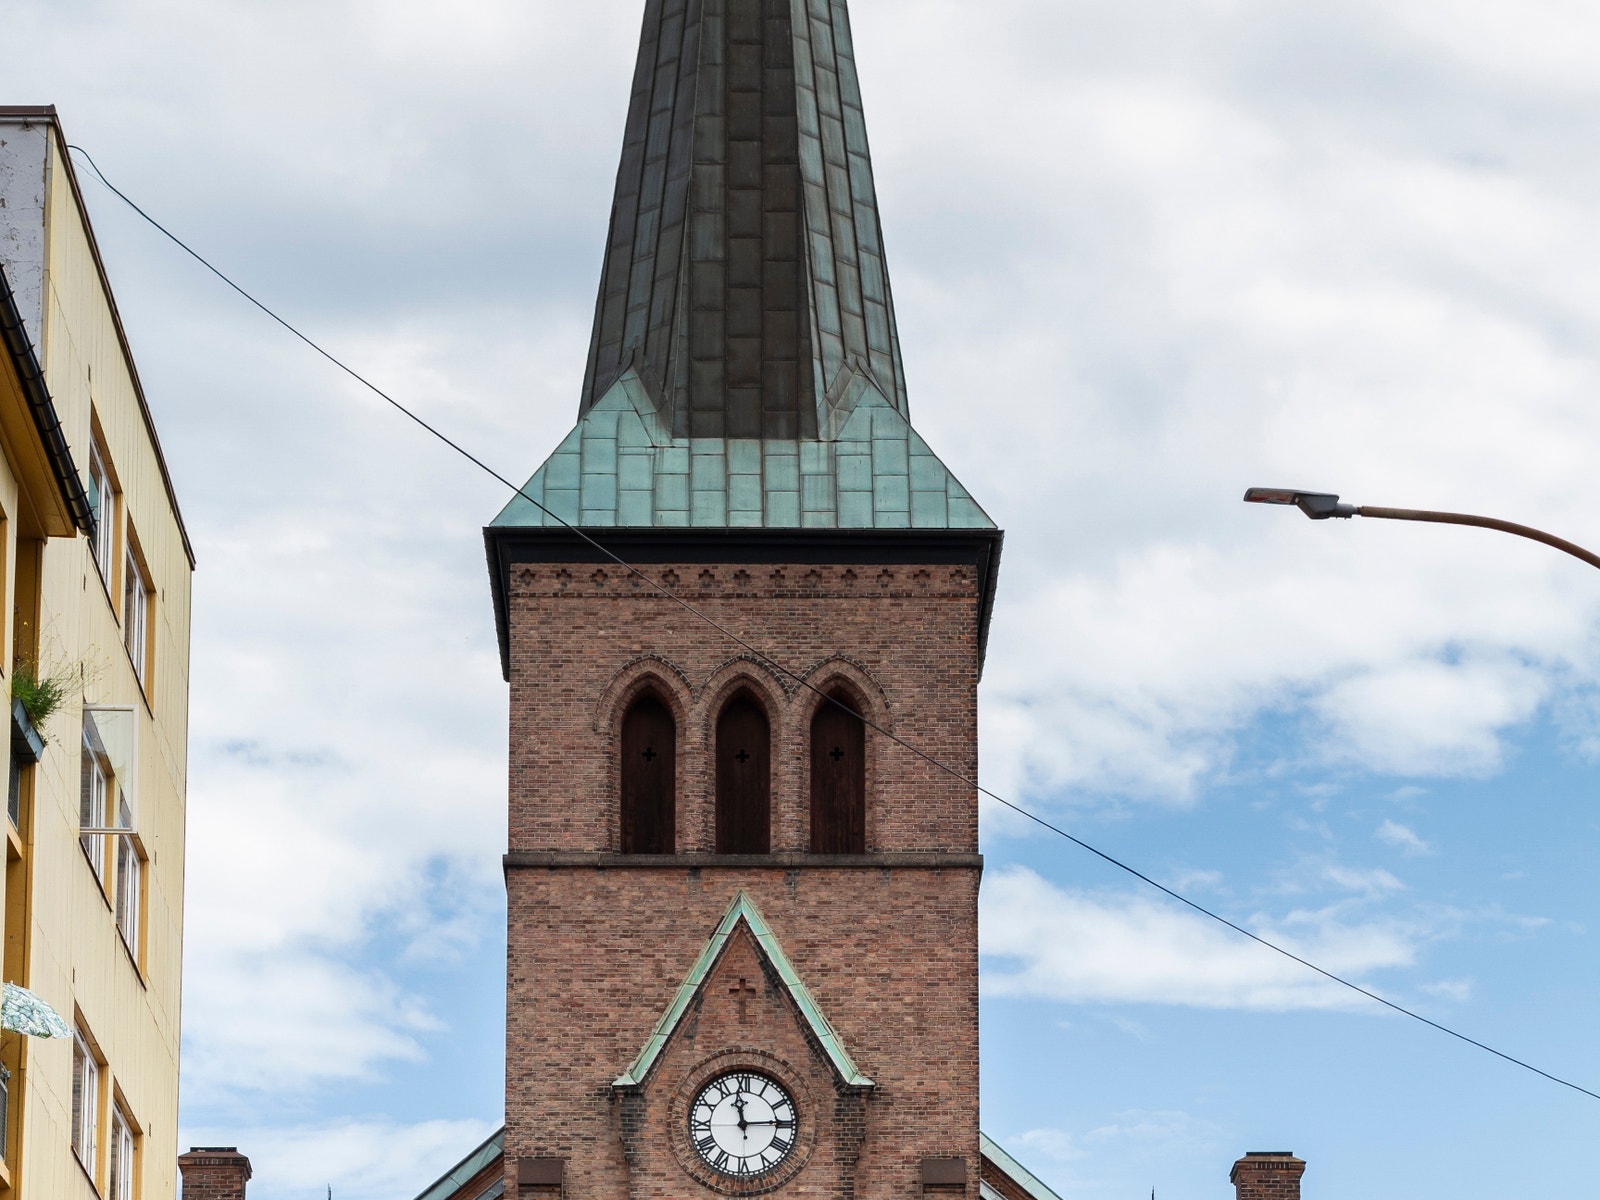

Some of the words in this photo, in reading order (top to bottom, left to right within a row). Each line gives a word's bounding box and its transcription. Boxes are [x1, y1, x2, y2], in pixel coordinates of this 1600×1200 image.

[712, 1079, 731, 1099] XI
[698, 1097, 716, 1111] X
[772, 1098, 787, 1110] II
[760, 1153, 773, 1168] V
